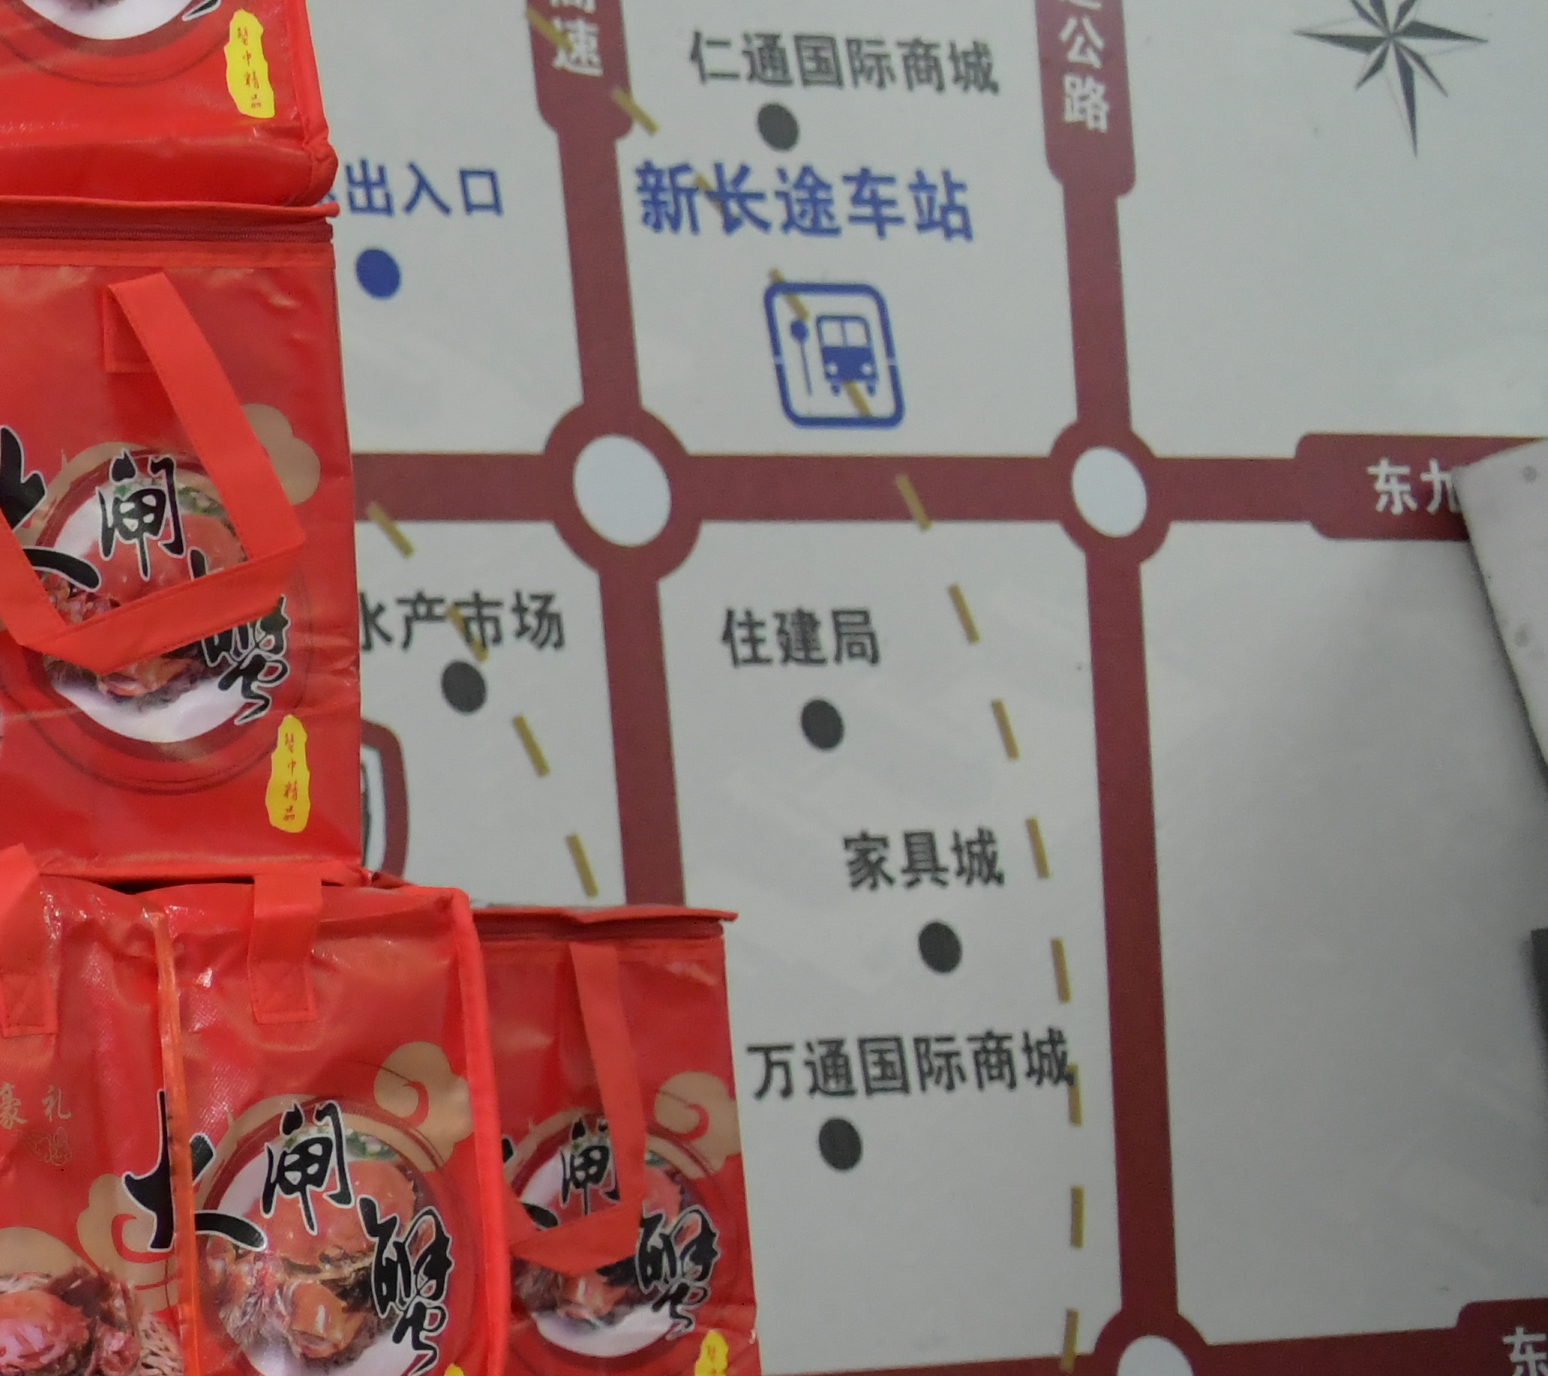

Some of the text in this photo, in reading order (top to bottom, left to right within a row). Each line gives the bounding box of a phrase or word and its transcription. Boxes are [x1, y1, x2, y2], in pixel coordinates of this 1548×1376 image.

[689, 28, 1001, 96] 仁通国际商城
[322, 158, 503, 216] 出入口
[636, 160, 975, 241] 新长途车站
[721, 606, 882, 669] 住建局
[842, 827, 1005, 893] 家具城
[747, 1028, 1078, 1102] 万通国际商城
[123, 1088, 451, 1375] 大闸蟹
